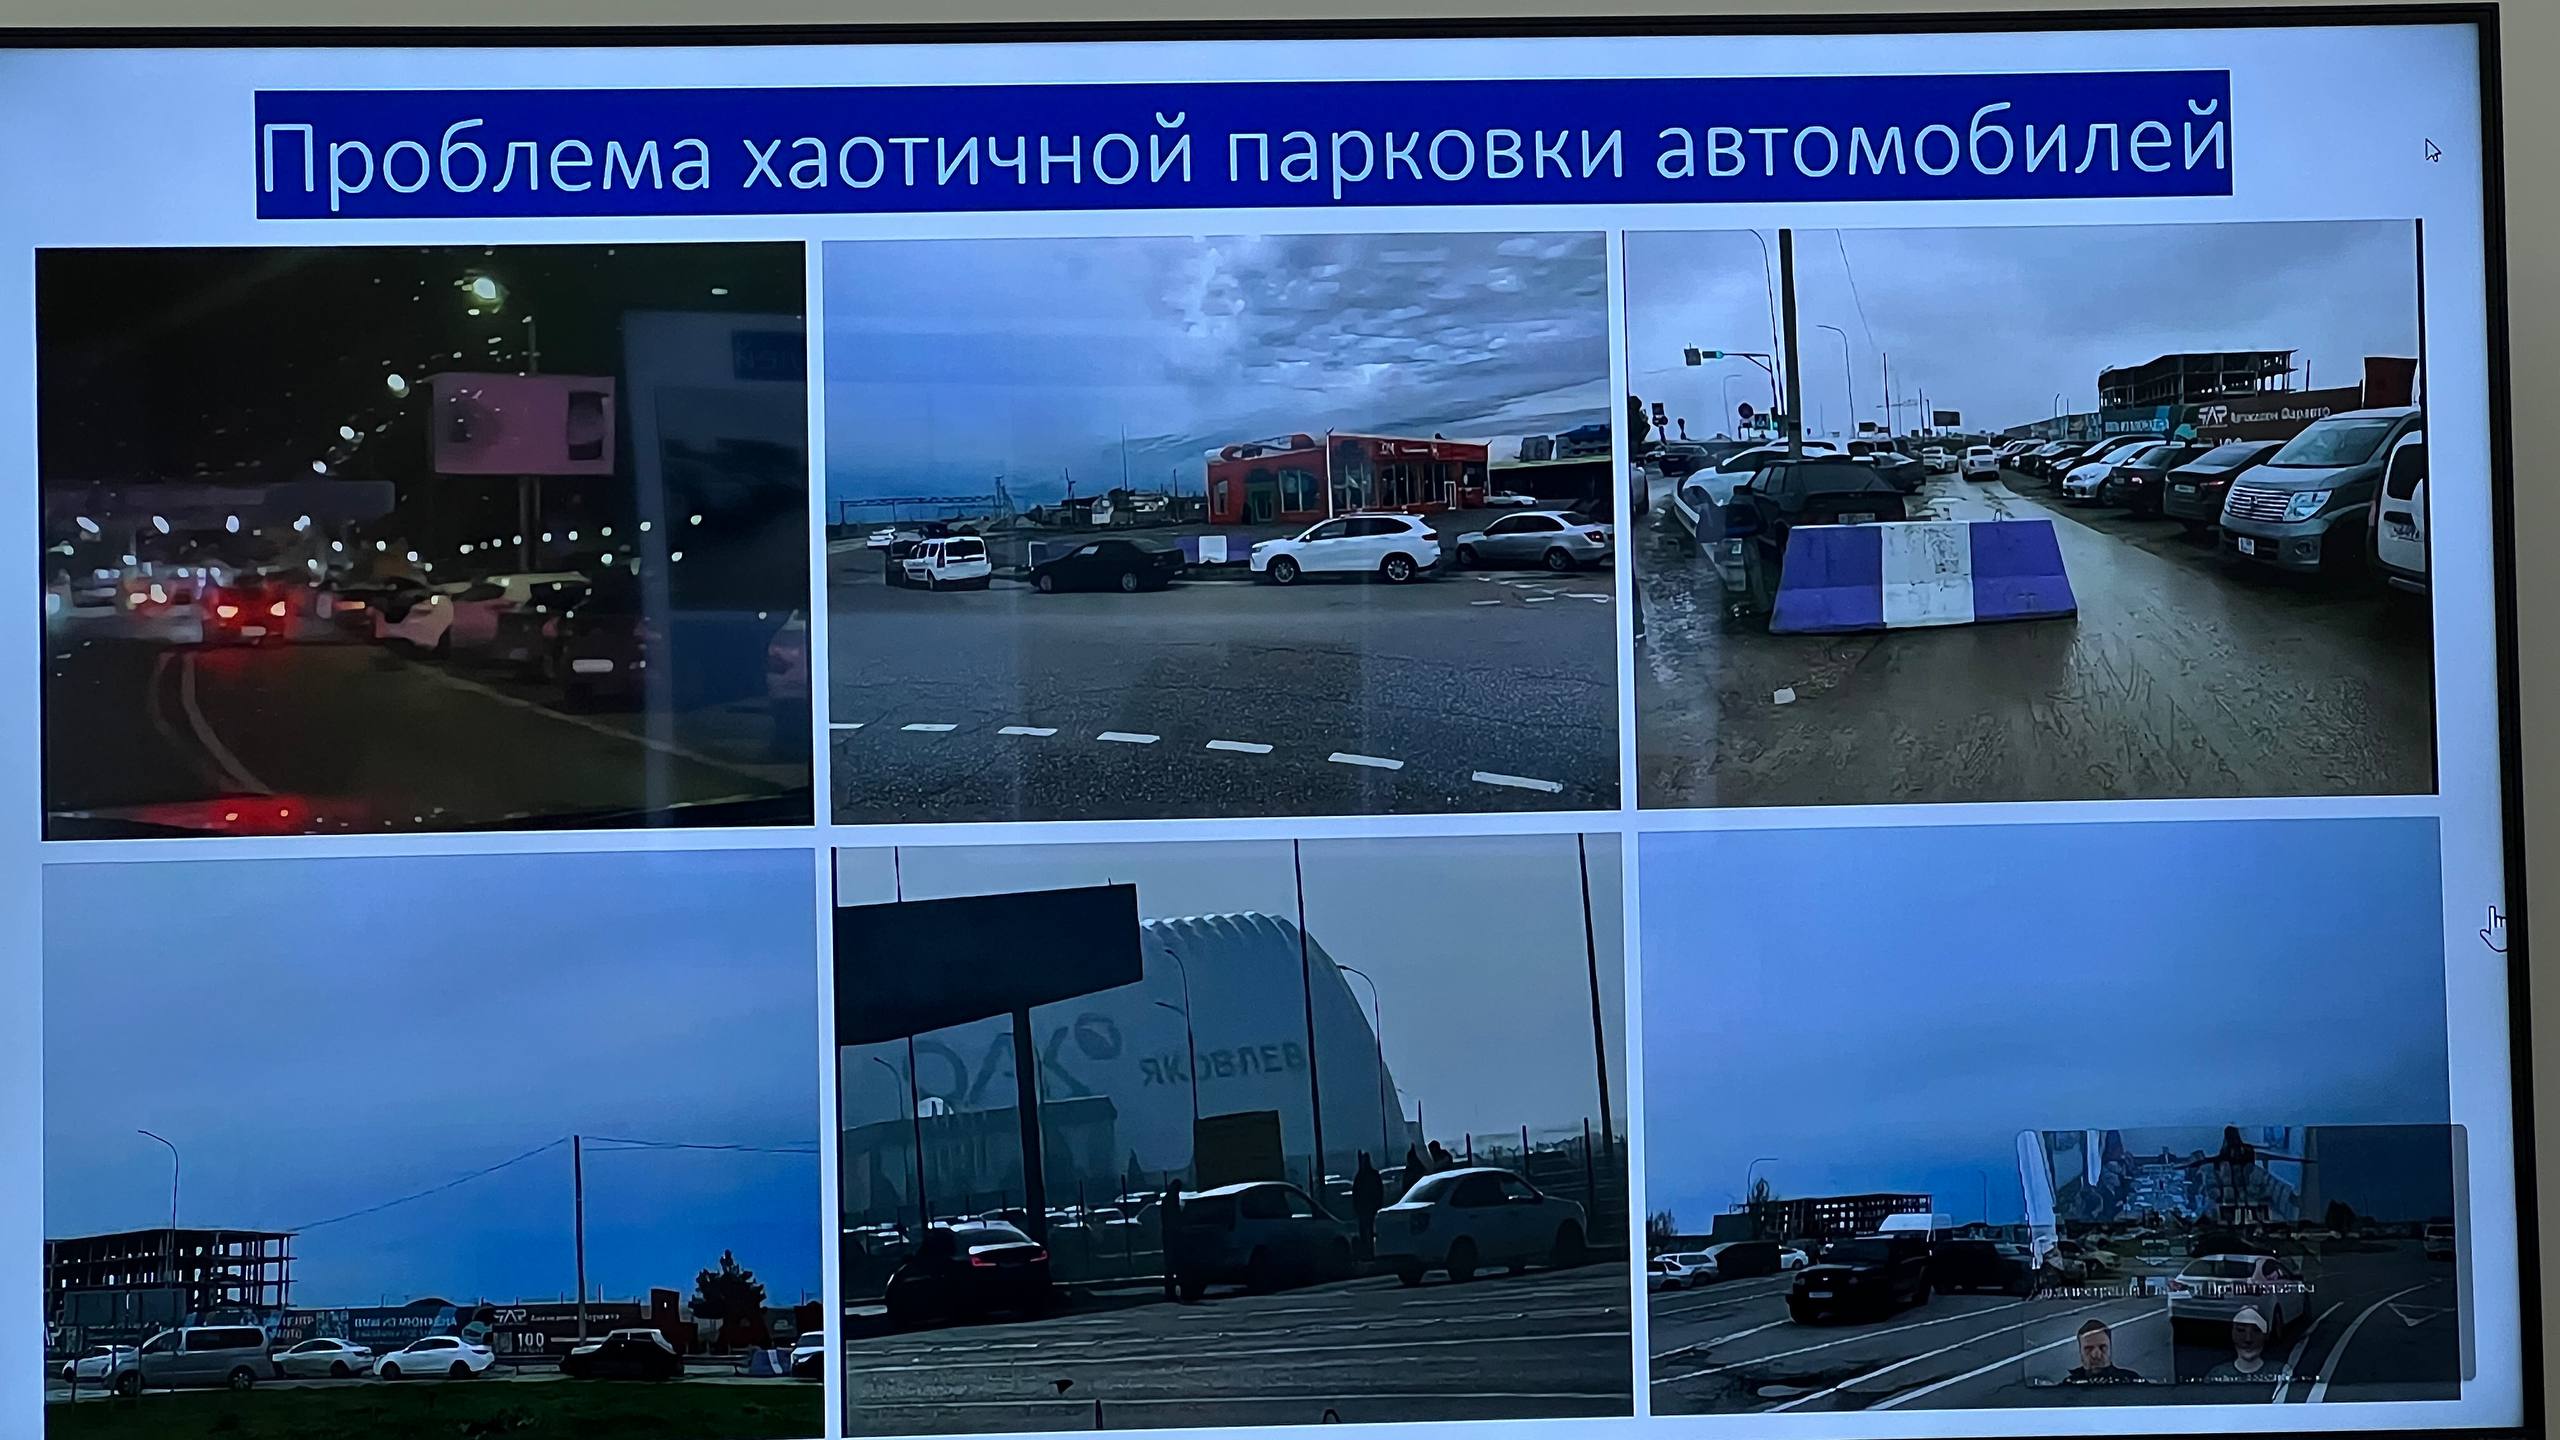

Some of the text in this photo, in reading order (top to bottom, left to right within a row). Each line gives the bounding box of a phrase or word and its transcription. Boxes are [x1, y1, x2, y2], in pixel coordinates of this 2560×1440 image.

[262, 98, 2226, 211] Проблема хаотичной парковки автомобилей
[1138, 1041, 1306, 1087] ЯКОВЛЕВ
[517, 1332, 545, 1348] 100
